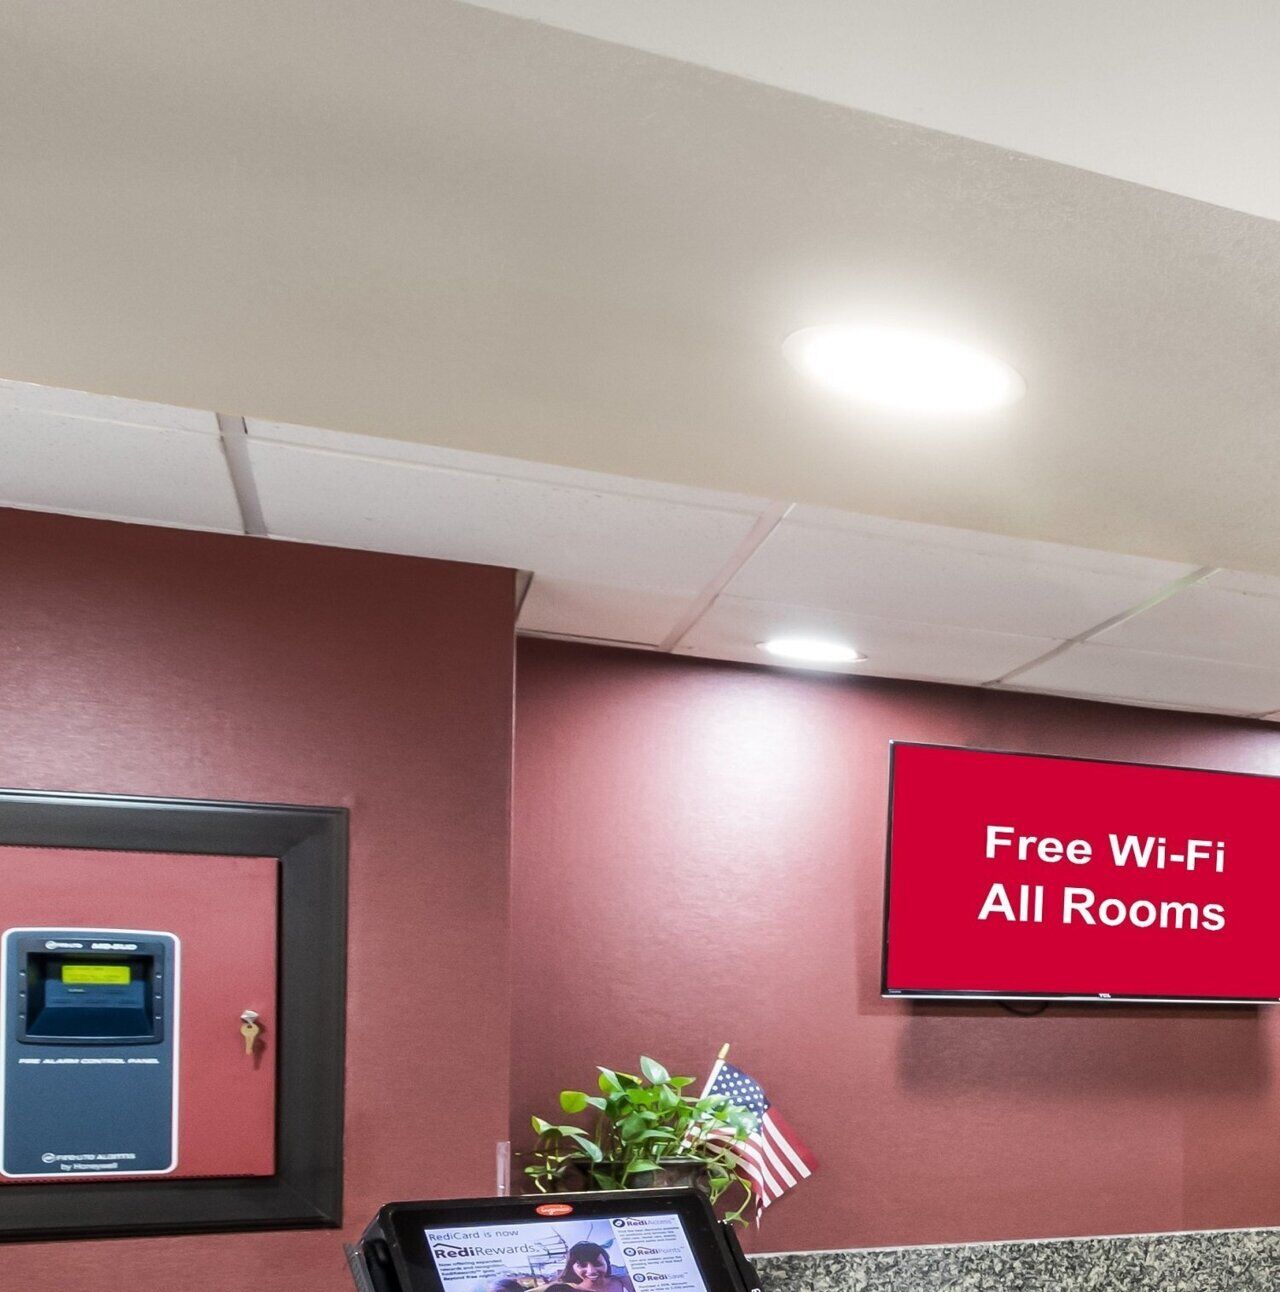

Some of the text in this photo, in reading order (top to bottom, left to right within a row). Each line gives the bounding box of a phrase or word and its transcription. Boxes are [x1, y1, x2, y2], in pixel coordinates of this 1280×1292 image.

[985, 825, 1225, 873] Free Wi-Fi
[977, 883, 1226, 931] All Rooms
[428, 1229, 519, 1242] RediCard is now
